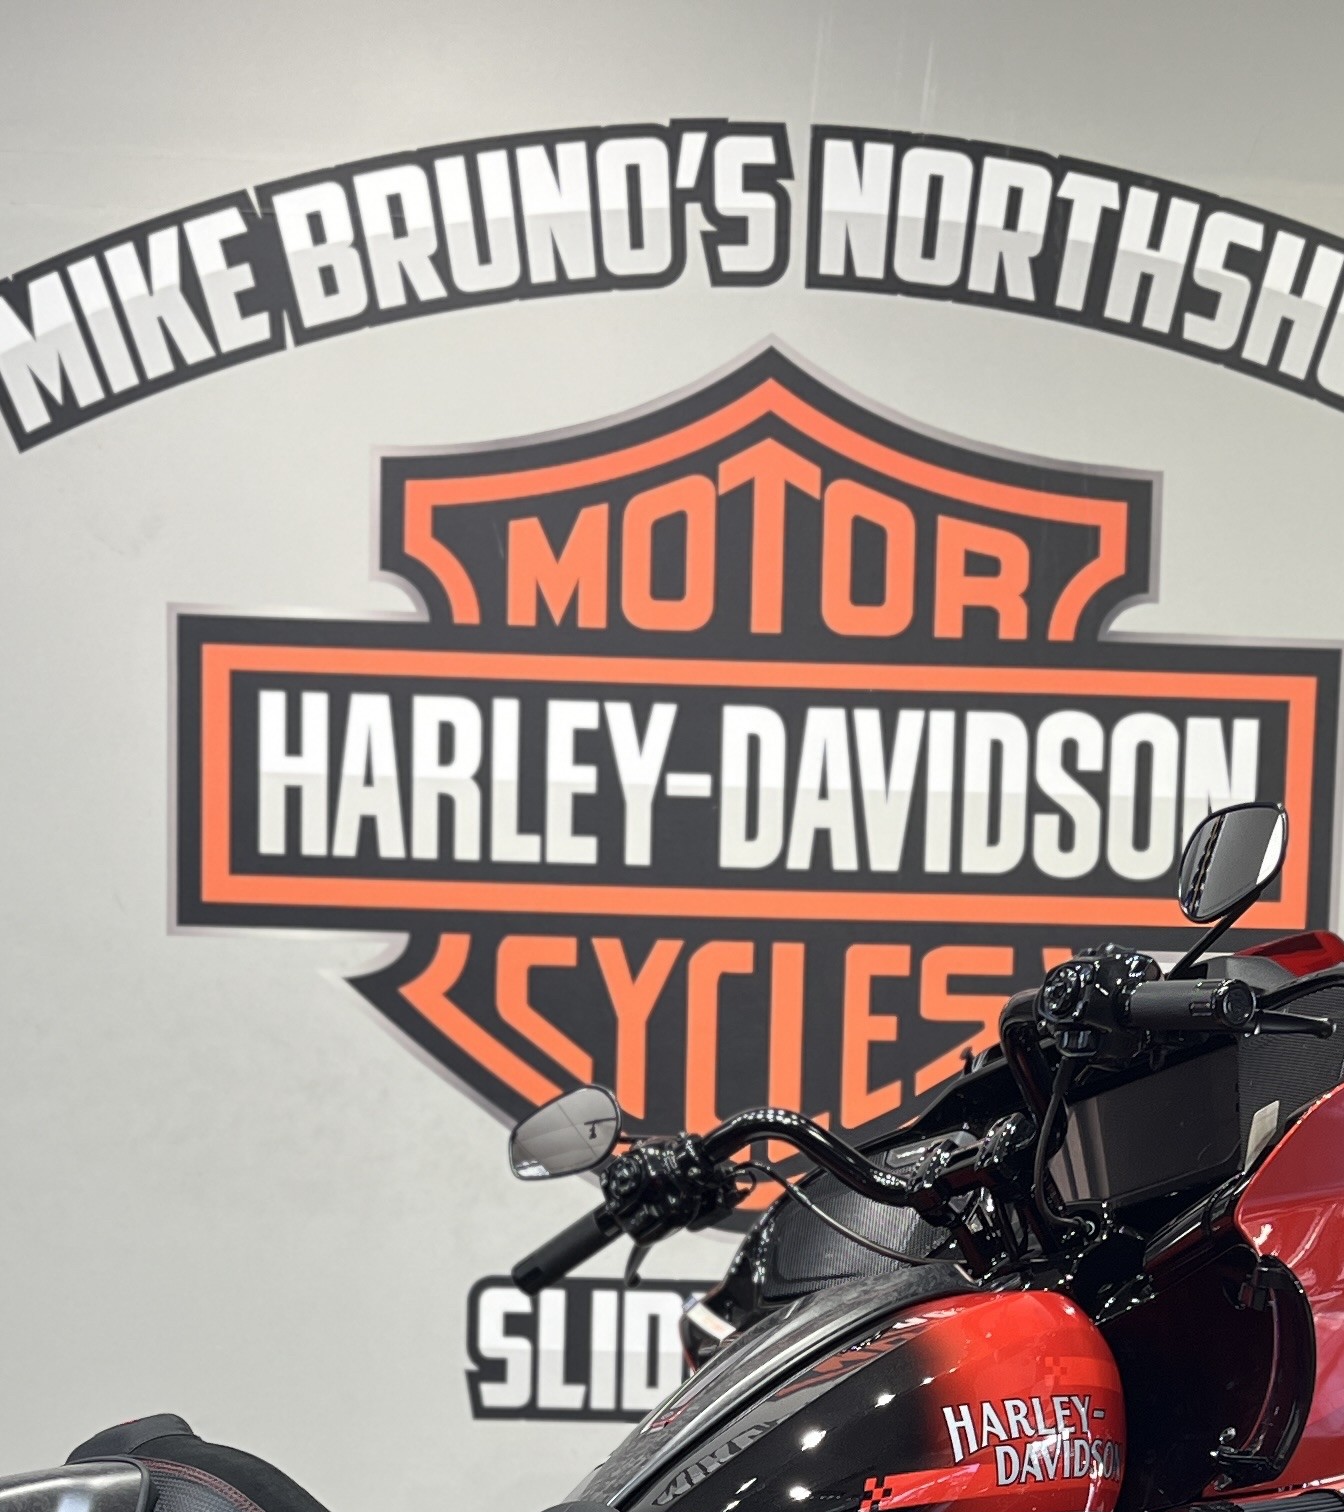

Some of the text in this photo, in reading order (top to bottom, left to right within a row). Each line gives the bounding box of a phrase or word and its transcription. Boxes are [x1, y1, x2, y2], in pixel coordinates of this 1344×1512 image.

[269, 130, 778, 331] BRUNO'S
[506, 436, 1031, 640] MOTOR
[258, 689, 1260, 882] HARLEY-DAVIDSON
[494, 933, 1014, 1162] CYCLES
[476, 1284, 706, 1410] SLID
[941, 1394, 1106, 1463] HARLEY-
[994, 1436, 1122, 1487] DAVIDSON
